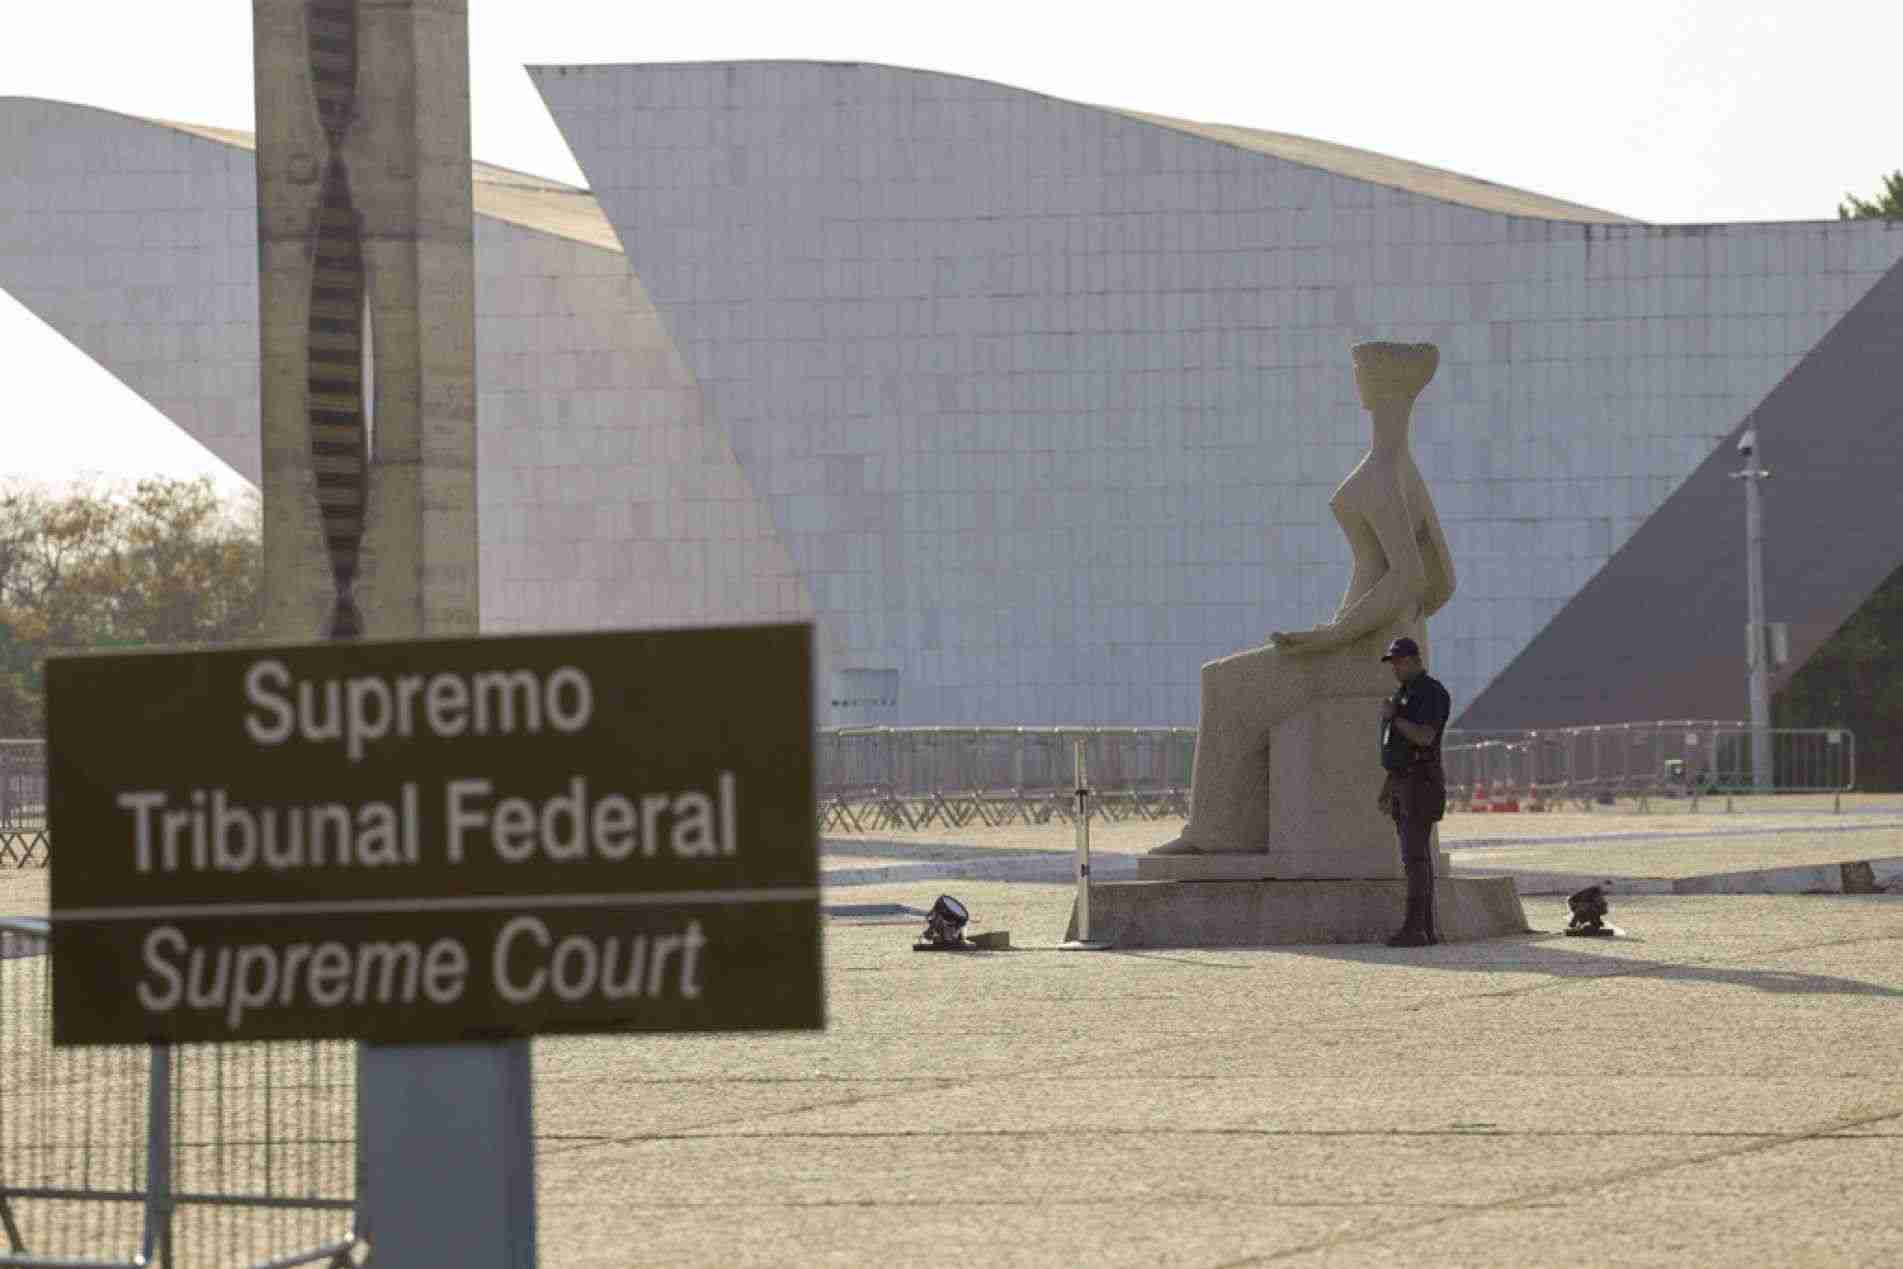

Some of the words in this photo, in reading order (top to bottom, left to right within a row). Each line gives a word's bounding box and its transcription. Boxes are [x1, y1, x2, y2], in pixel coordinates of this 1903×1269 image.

[245, 661, 592, 759] Supremo
[118, 784, 419, 871] Tribunal
[446, 772, 738, 863] Federal
[138, 926, 467, 1027] Supreme
[494, 916, 705, 1001] Court
